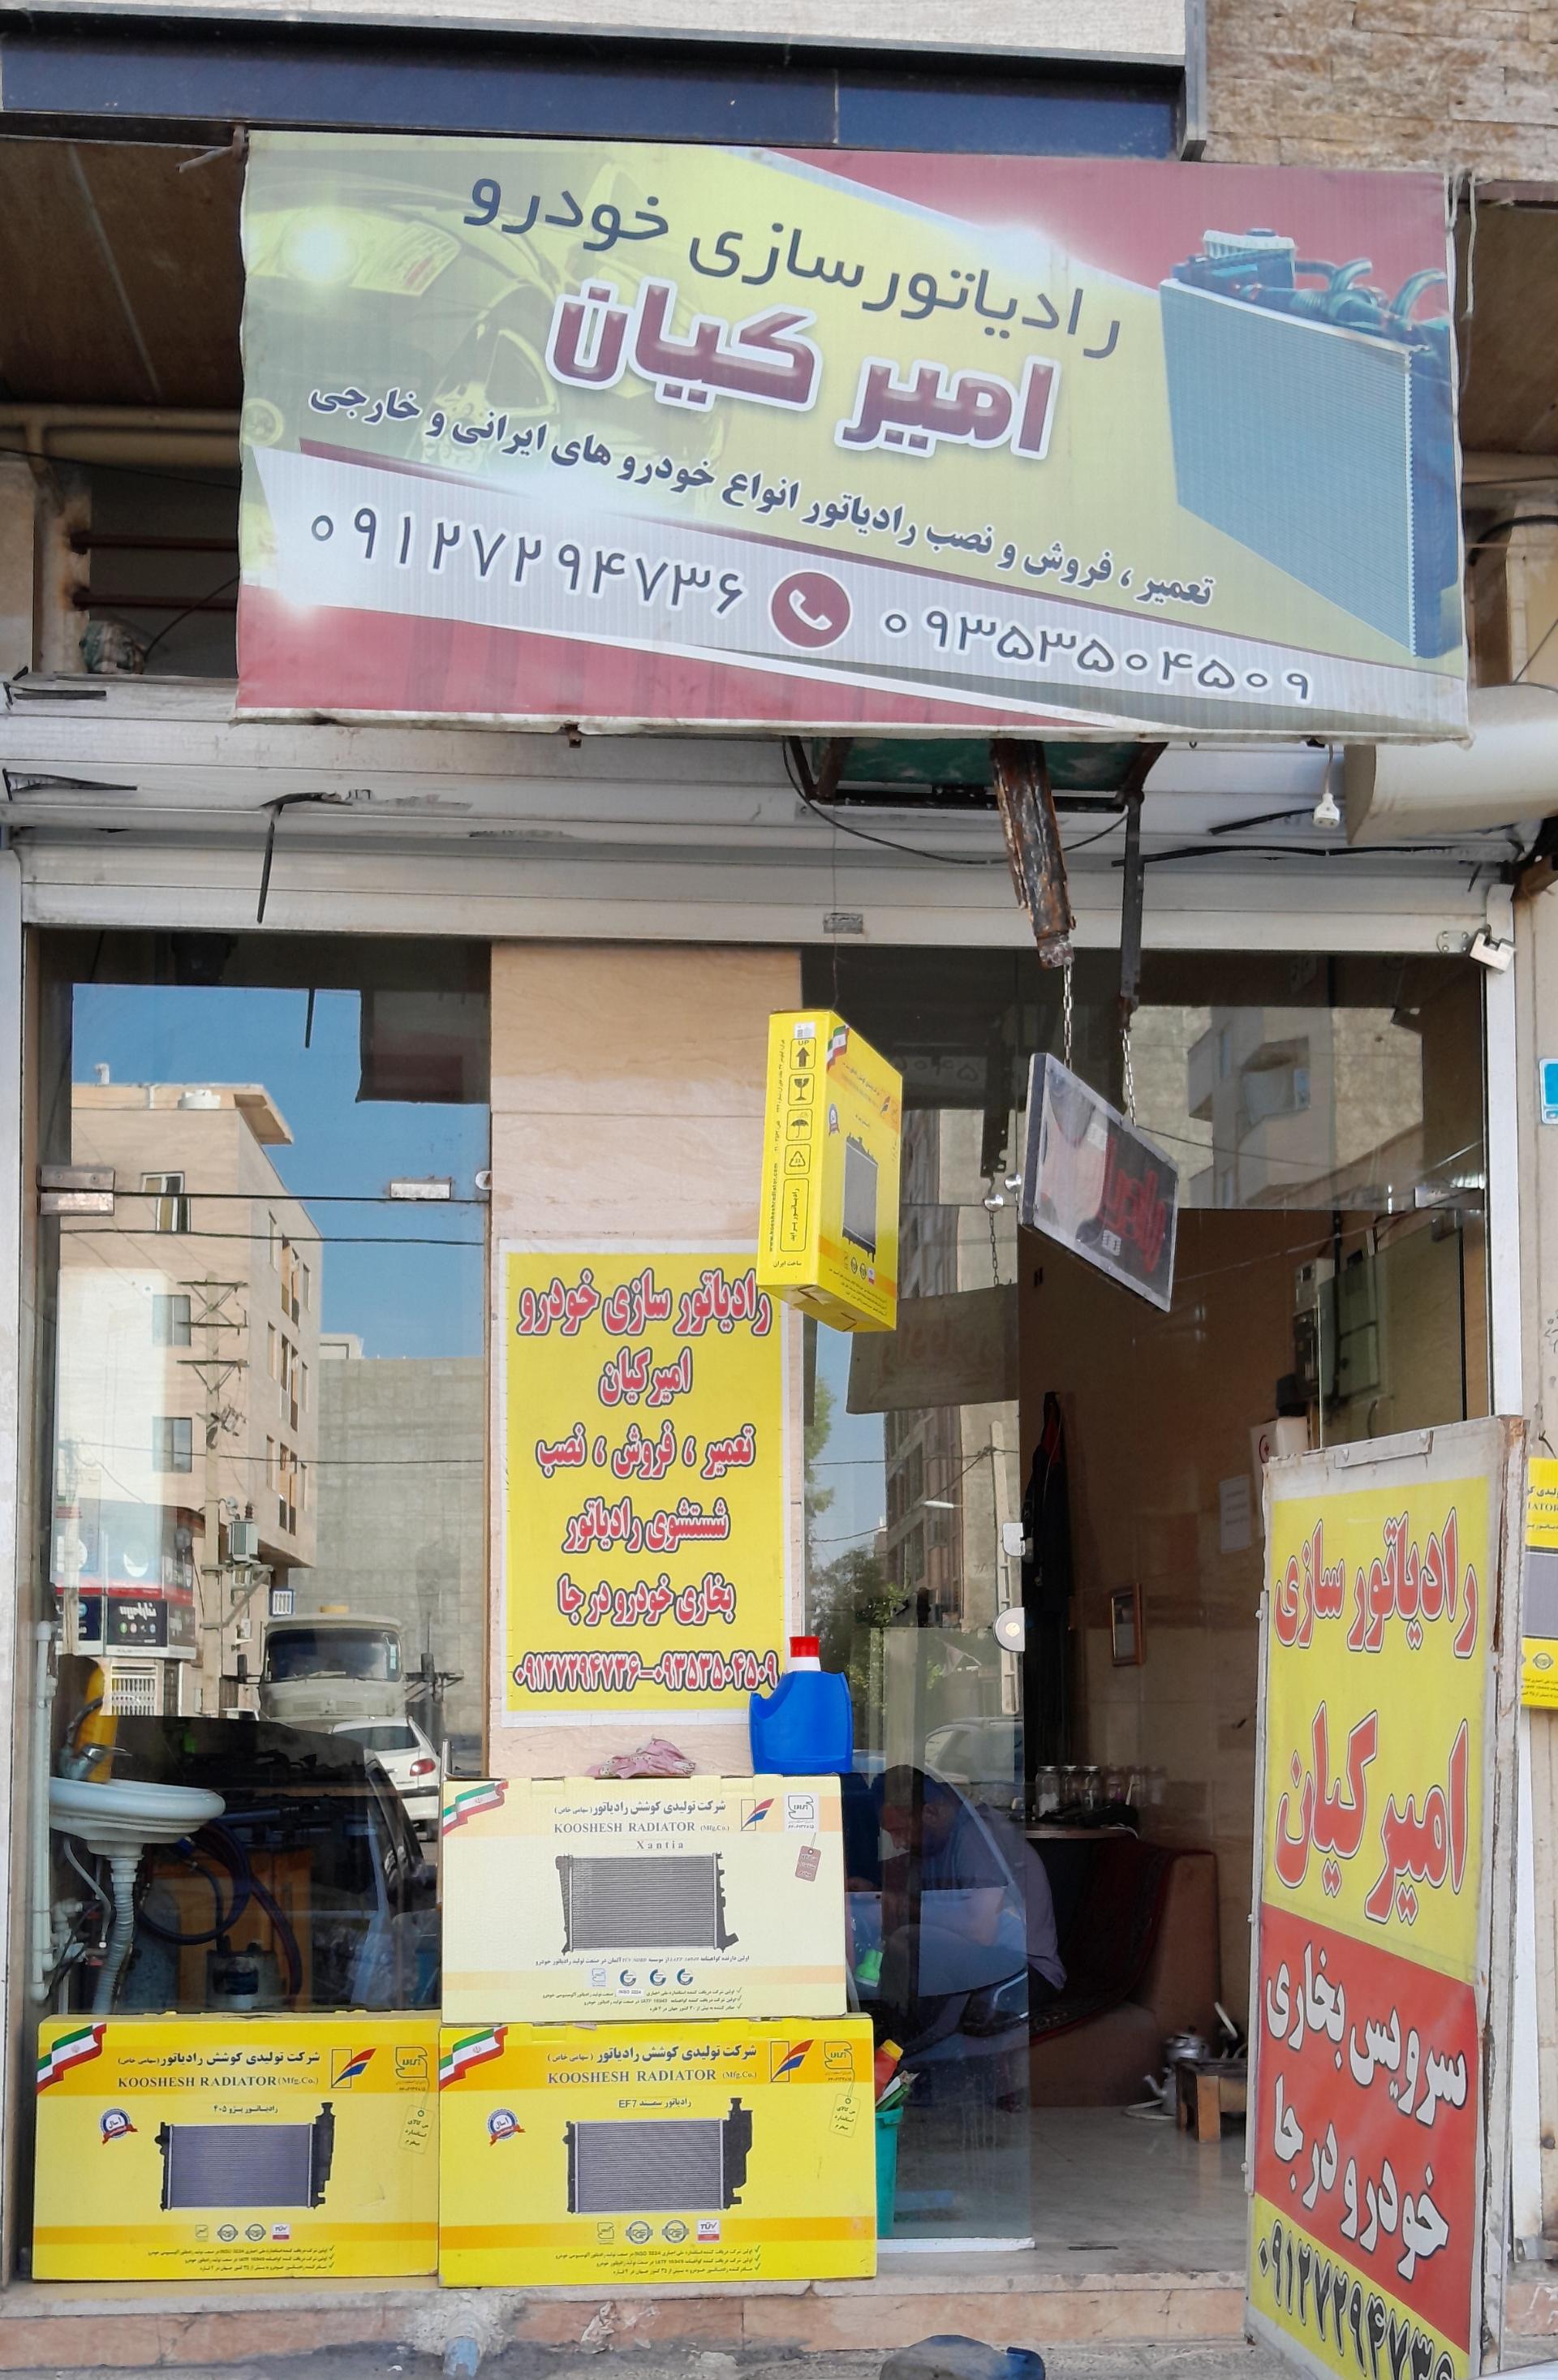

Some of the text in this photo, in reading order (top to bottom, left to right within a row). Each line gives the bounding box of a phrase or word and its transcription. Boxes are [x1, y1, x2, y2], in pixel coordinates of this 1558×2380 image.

[464, 175, 1121, 359] رادیاتور سازی خودرو
[549, 281, 1058, 456] امیر کیان
[310, 386, 420, 424] خارجی
[424, 410, 445, 437] و
[451, 413, 548, 457] ایرانی
[550, 433, 613, 467] های
[616, 455, 716, 493] خودرو
[721, 471, 801, 514] انواع
[800, 493, 917, 546] رادیاتور
[926, 525, 993, 555] نصب
[996, 541, 1017, 570] و
[310, 507, 745, 616] ۰۹۱۲۷۲۹۴۷۳۶
[1023, 542, 1113, 588] فروش
[1135, 575, 1215, 606] تعمیر
[883, 609, 1310, 700] ۰۹۳۵۳۵۰۴۵۰۹
[516, 1268, 601, 1336] خودرو
[602, 1267, 673, 1336] سازی
[674, 1267, 773, 1336] رادیاتور
[598, 1346, 693, 1407] امیر کیان
[536, 1422, 587, 1478] نصب
[611, 1419, 677, 1479] فروش
[700, 1422, 756, 1479] تعمیر
[562, 1495, 642, 1552] رادیاتور
[611, 1573, 674, 1626] خودرو
[674, 1572, 737, 1625] بخاری
[1274, 1506, 1479, 1659] رادیاتور سازی
[592, 1801, 629, 1816] رادیاتور
[630, 1801, 661, 1814] کوشش
[663, 1800, 696, 1814] تولیدی
[697, 1799, 726, 1814] شرکت
[1274, 1699, 1470, 1925] امیر کیان
[554, 1823, 622, 1833] KOOSHESH
[628, 1821, 695, 1832] RADIATOR
[722, 2044, 756, 2060] شرکت
[1267, 1941, 1468, 2126] سرویس بخاری
[161, 2052, 203, 2067] رادیاتور
[206, 2051, 243, 2066] کوشش
[246, 2051, 284, 2065] تولیدی
[286, 2051, 320, 2065] شرکت
[596, 2046, 639, 2064] رادیاتور
[642, 2046, 679, 2062] کوشش
[682, 2045, 721, 2061] تولیدی
[118, 2076, 319, 2088] KOOSHESH RADIATOR (Mfg.Co.)
[548, 2069, 757, 2083] KOOSHESH RADIATOR (Mfg.Co.)
[245, 2104, 278, 2114] رادیاتور
[618, 2099, 637, 2108] EF7
[665, 2098, 691, 2108] رادیاتور
[1341, 2160, 1450, 2281] خودرو
